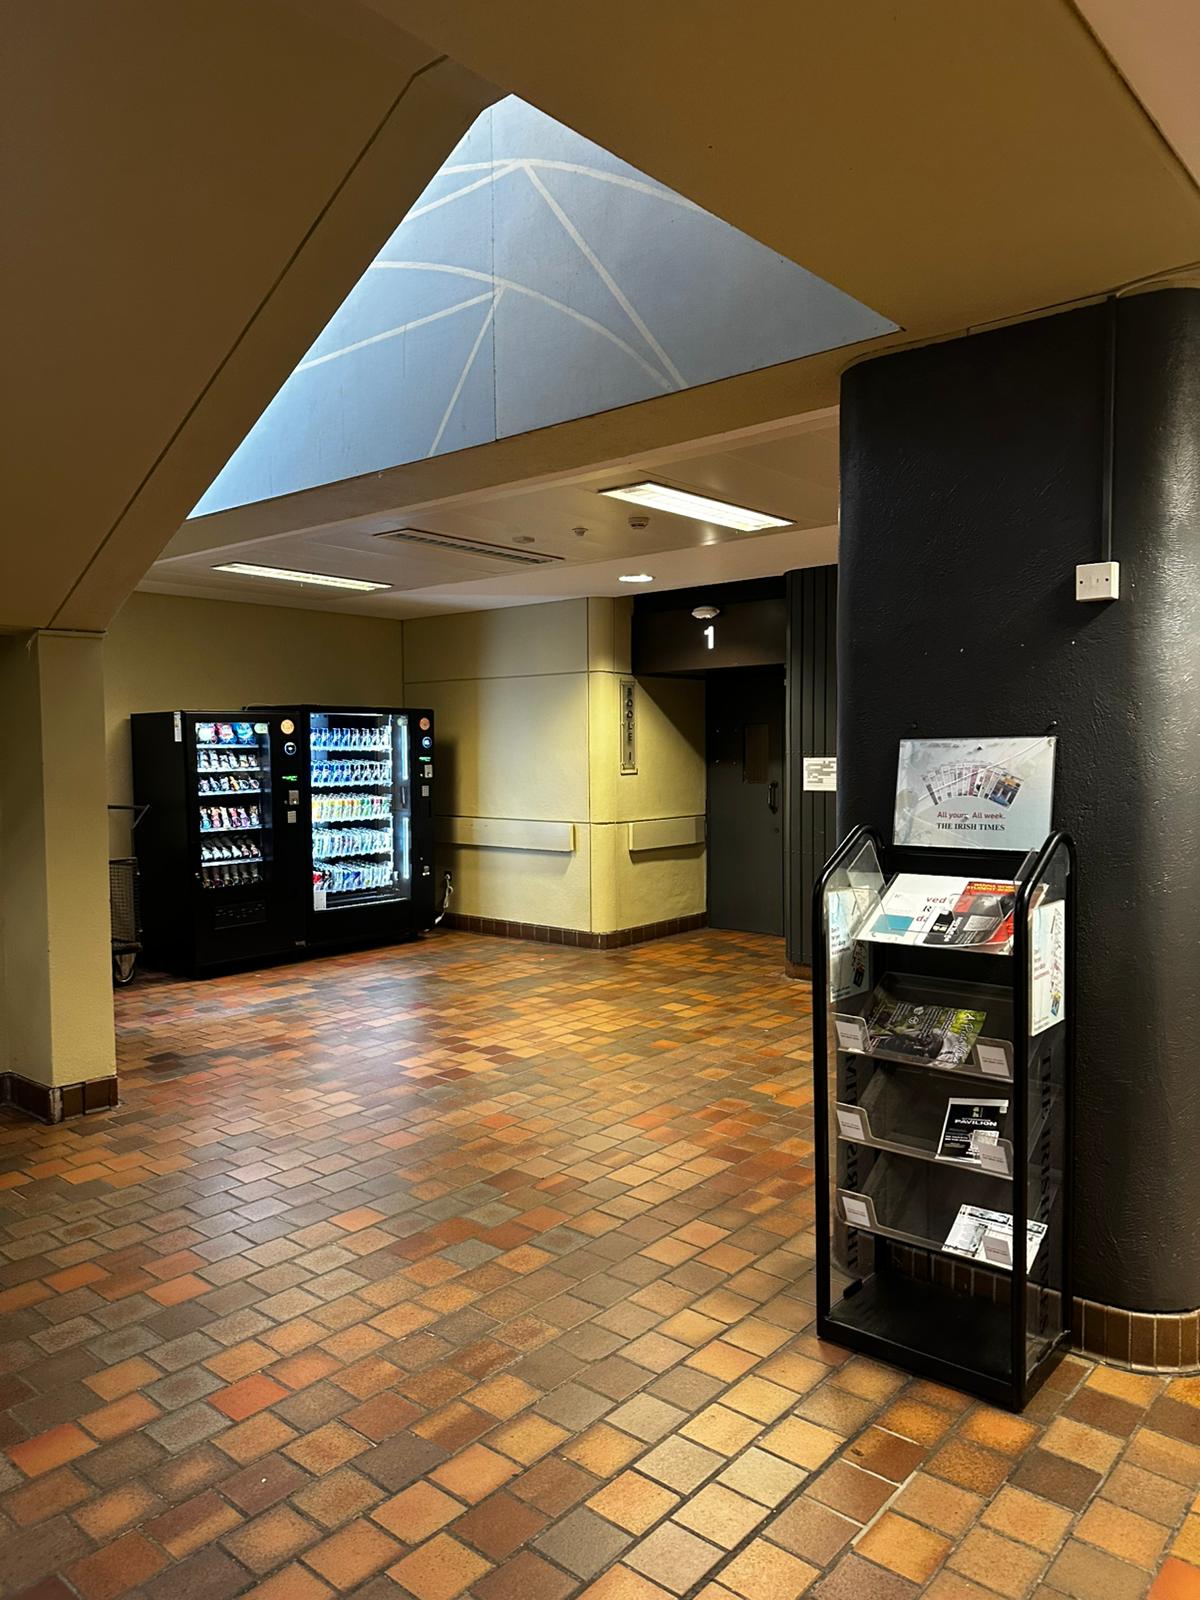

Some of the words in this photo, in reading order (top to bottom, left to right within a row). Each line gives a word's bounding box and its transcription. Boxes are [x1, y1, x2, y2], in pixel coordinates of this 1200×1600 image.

[703, 625, 714, 649] 1
[937, 811, 947, 819] All
[948, 812, 969, 820] your
[972, 811, 982, 819] All
[936, 822, 953, 830] THE
[954, 823, 977, 831] IRISH
[979, 823, 1006, 831] TIMES
[954, 1119, 998, 1127] PAVILION
